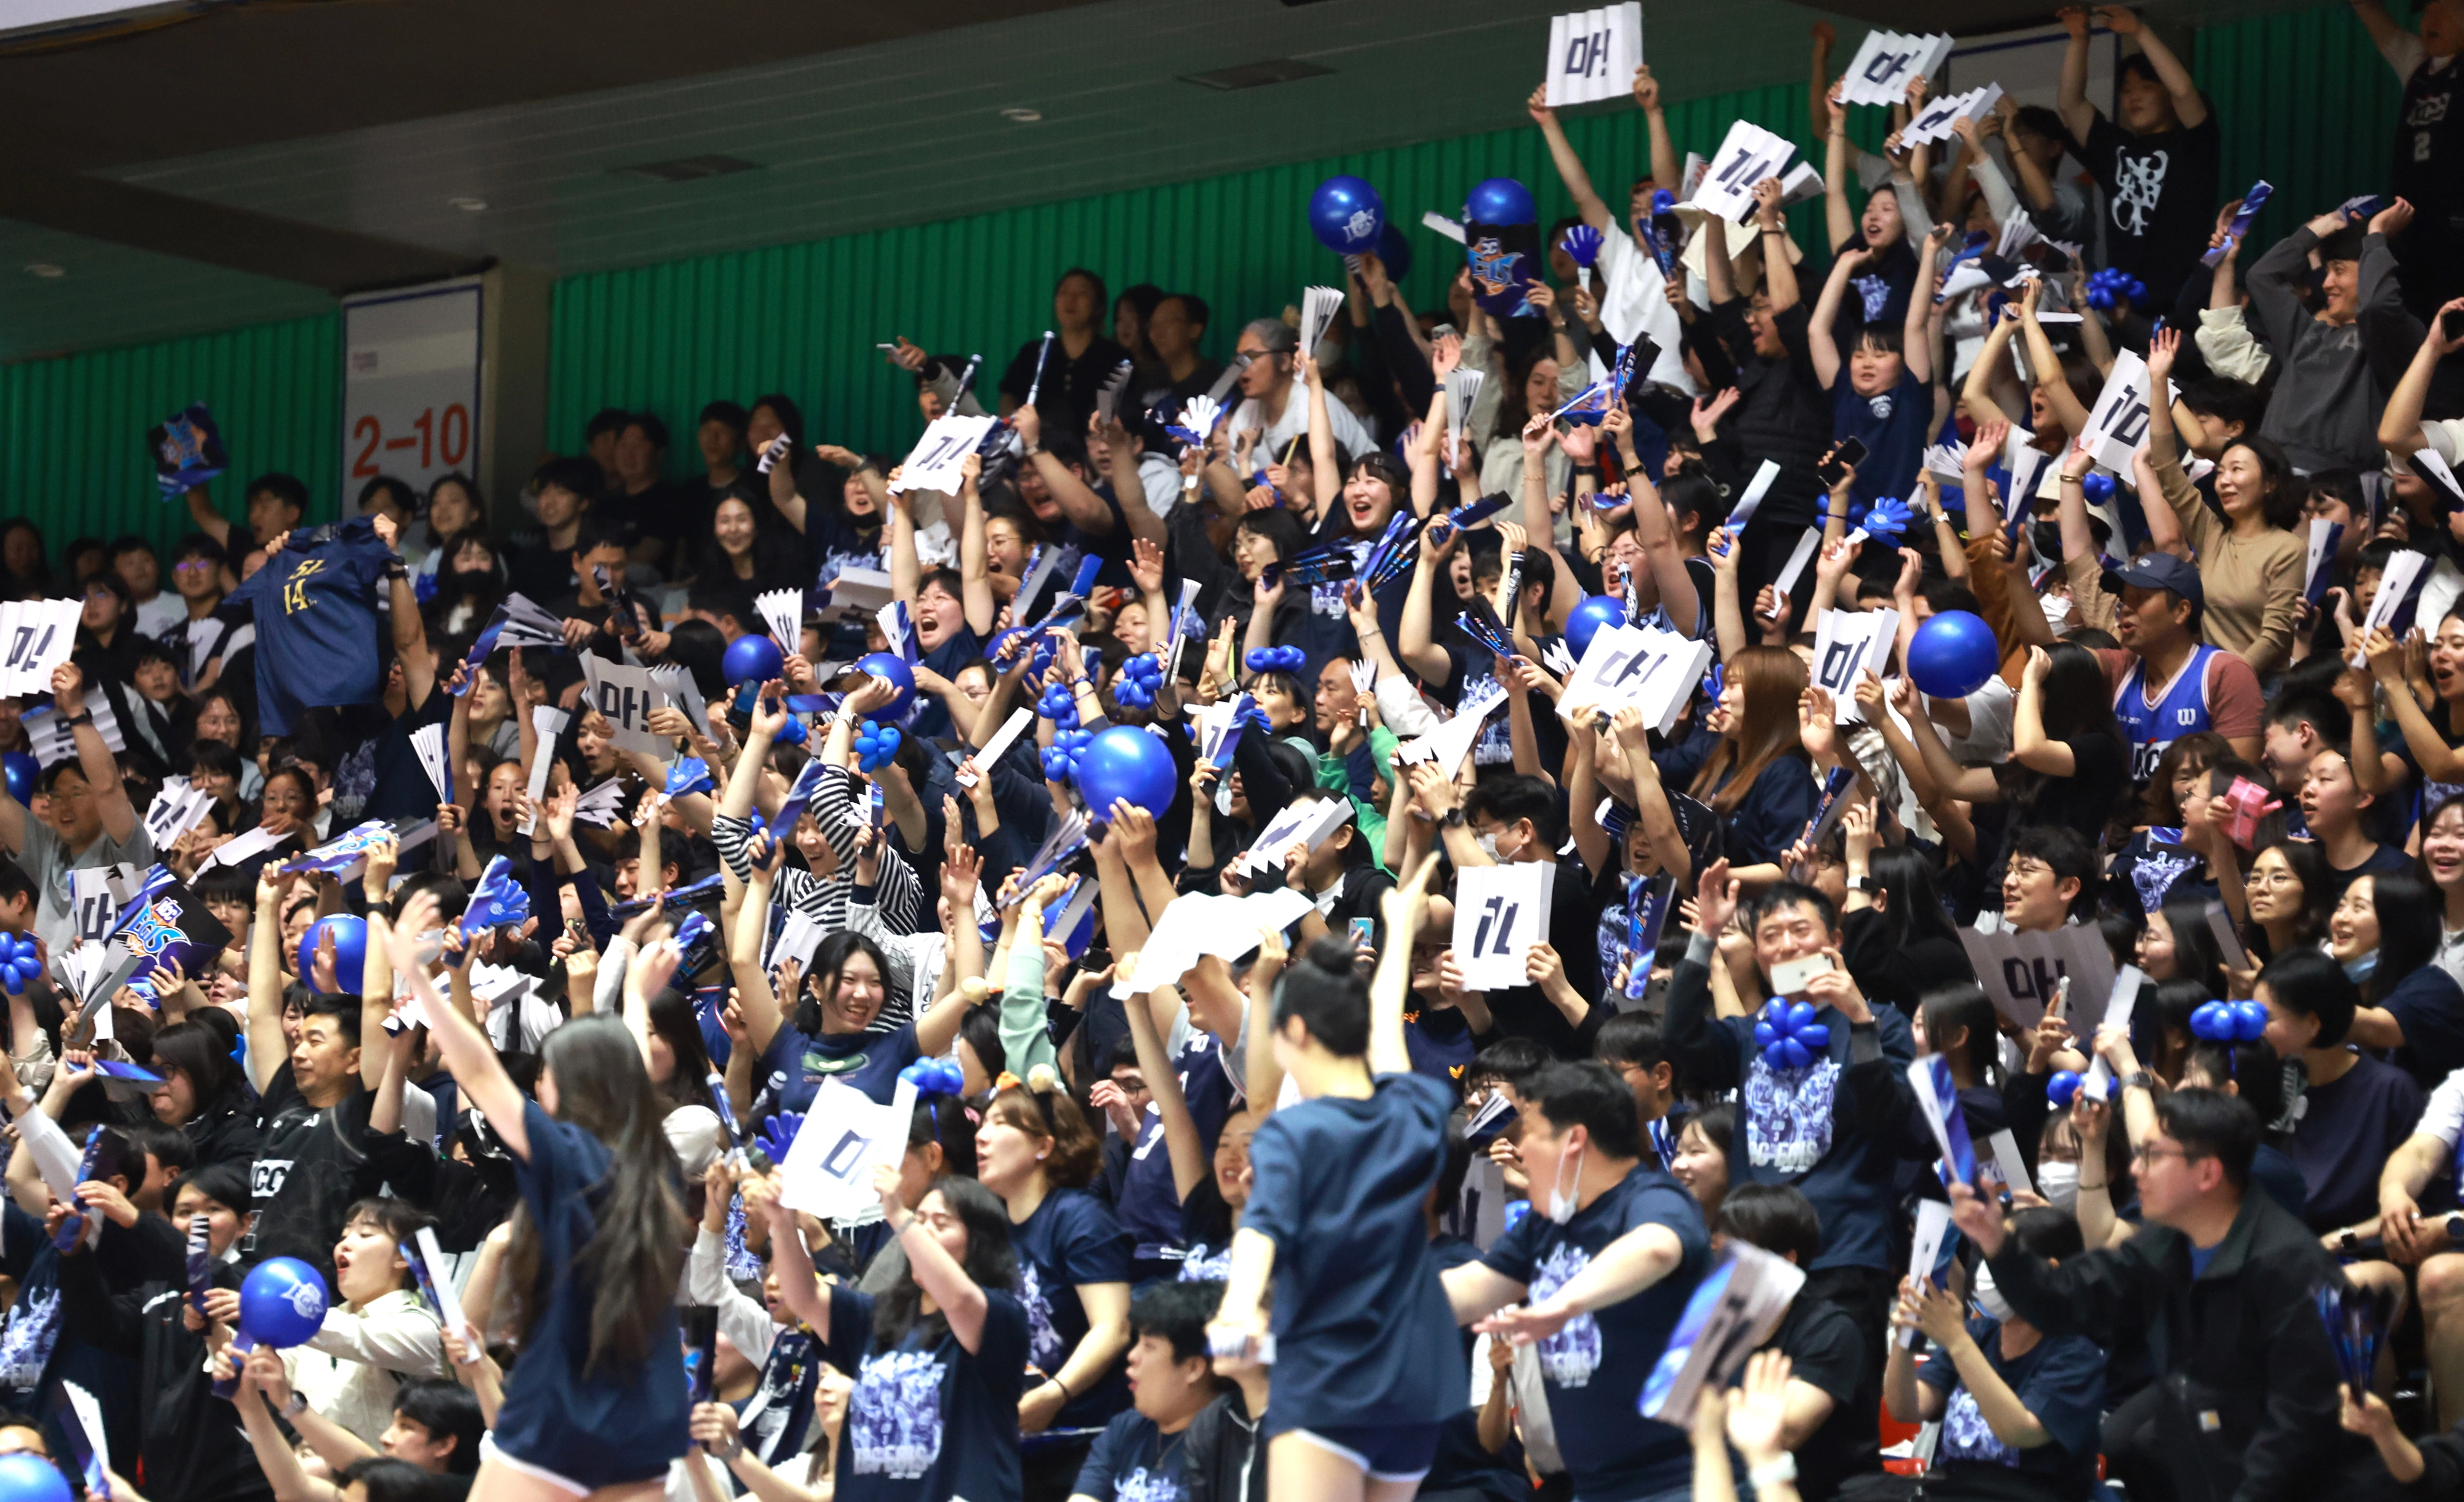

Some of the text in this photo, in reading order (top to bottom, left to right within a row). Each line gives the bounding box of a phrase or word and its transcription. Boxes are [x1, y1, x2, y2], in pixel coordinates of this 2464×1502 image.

[1565, 28, 1611, 78] 마!
[353, 404, 469, 478] 2-10
[284, 578, 308, 615] 14
[599, 681, 649, 733] 마!
[115, 893, 192, 955] EGIS
